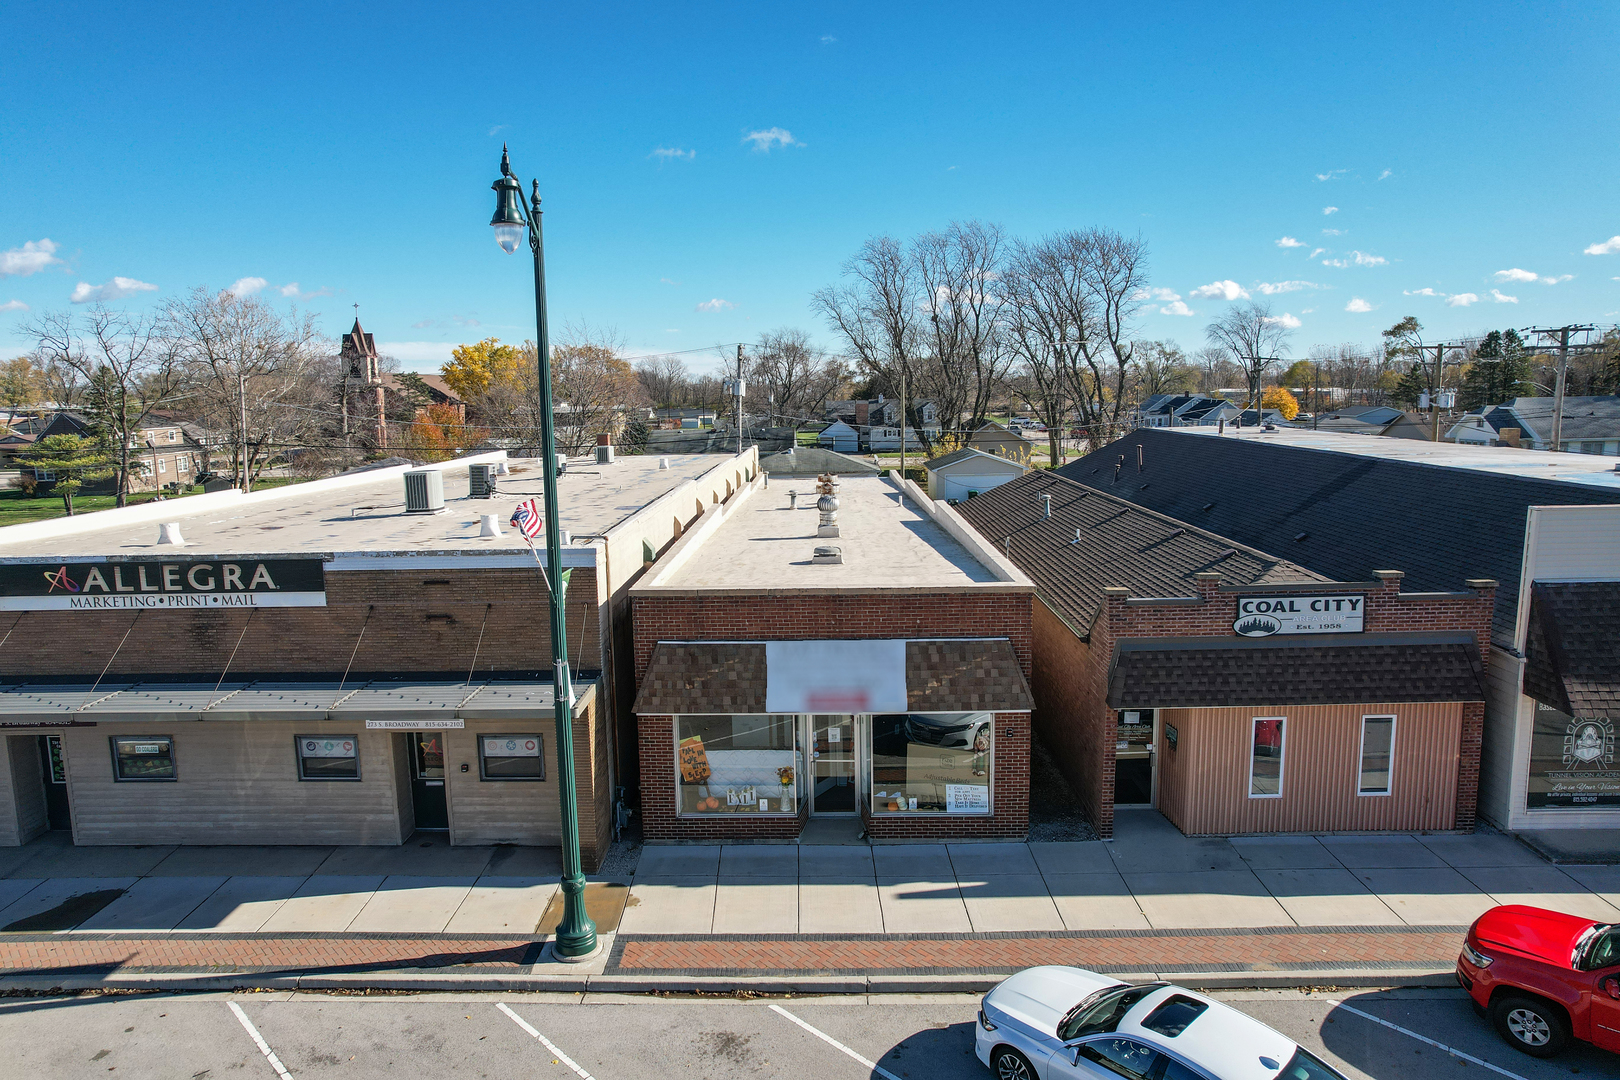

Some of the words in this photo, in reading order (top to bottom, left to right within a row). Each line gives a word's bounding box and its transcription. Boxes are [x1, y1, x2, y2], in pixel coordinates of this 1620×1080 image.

[83, 563, 277, 592] ALLEGRA
[70, 594, 156, 608] MARKETING
[168, 594, 211, 608] PRINT
[221, 594, 258, 606] MAIL
[1242, 600, 1301, 614] COAL
[1310, 598, 1362, 612] CITY
